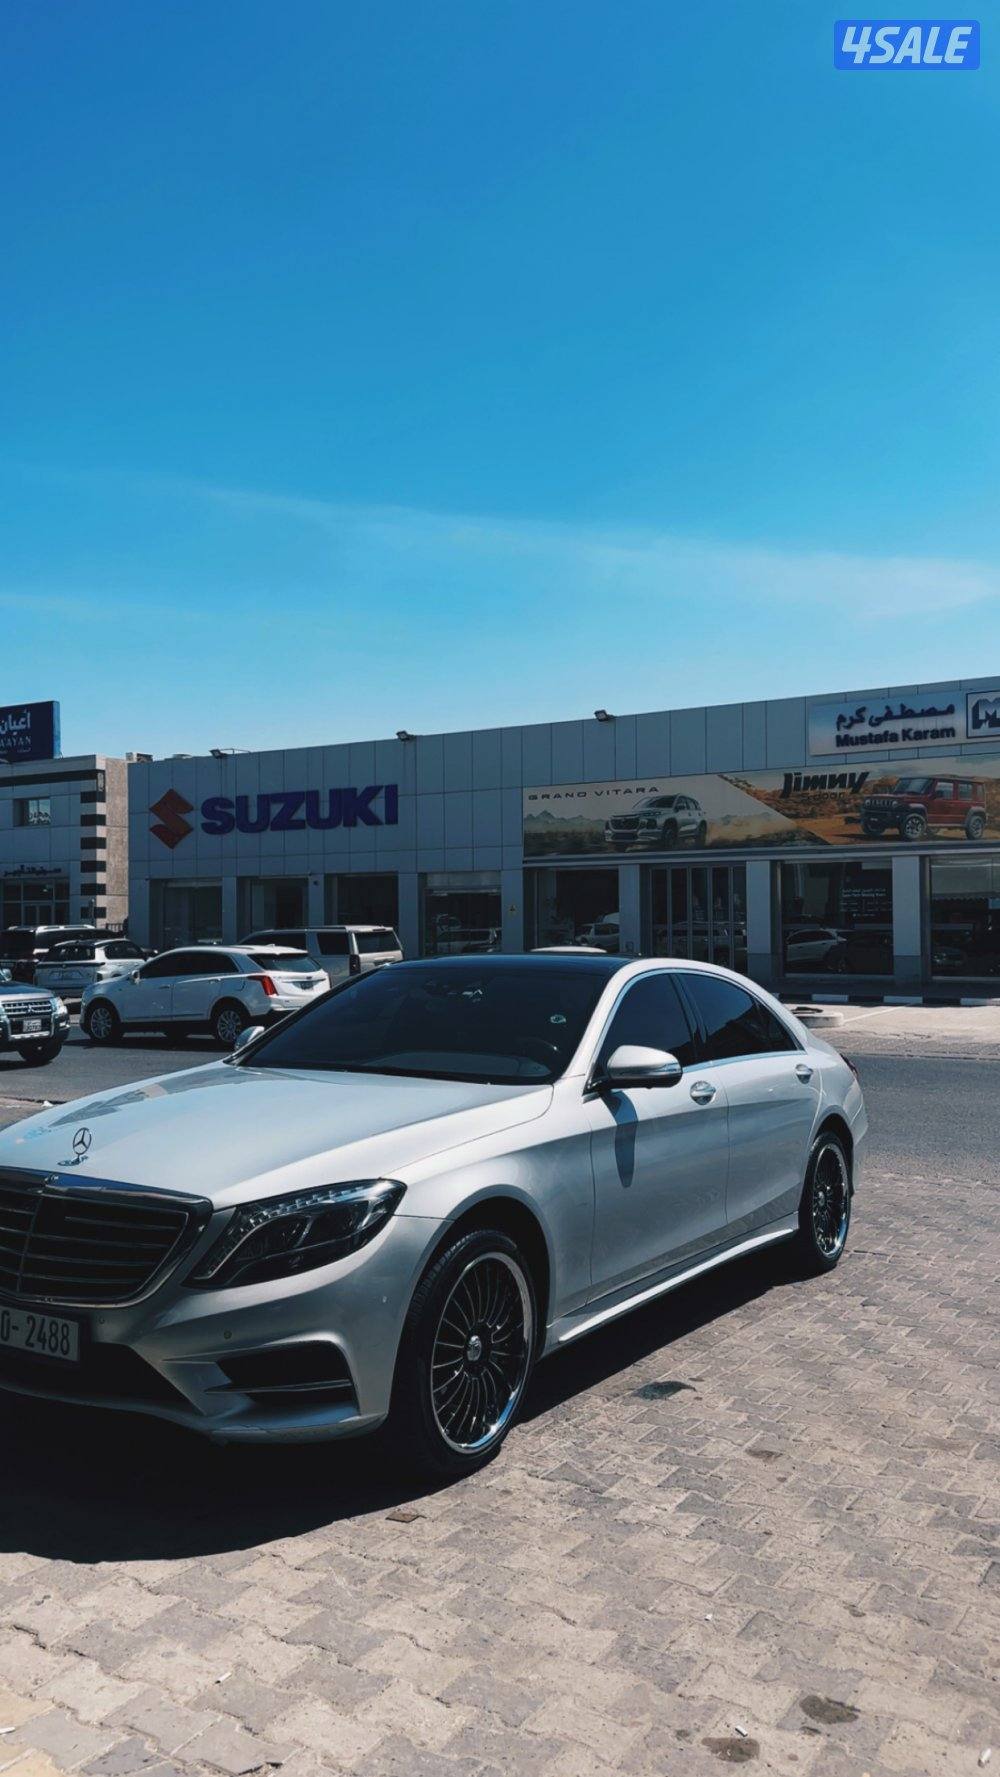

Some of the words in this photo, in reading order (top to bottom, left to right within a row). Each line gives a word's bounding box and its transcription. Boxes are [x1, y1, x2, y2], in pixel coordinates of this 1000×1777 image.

[836, 706, 867, 731] كرم
[835, 730, 899, 747] Mustafa
[902, 726, 956, 742] Karam
[528, 791, 587, 801] GRAND
[594, 786, 659, 797] VITARA
[201, 784, 399, 835] SUZUKI
